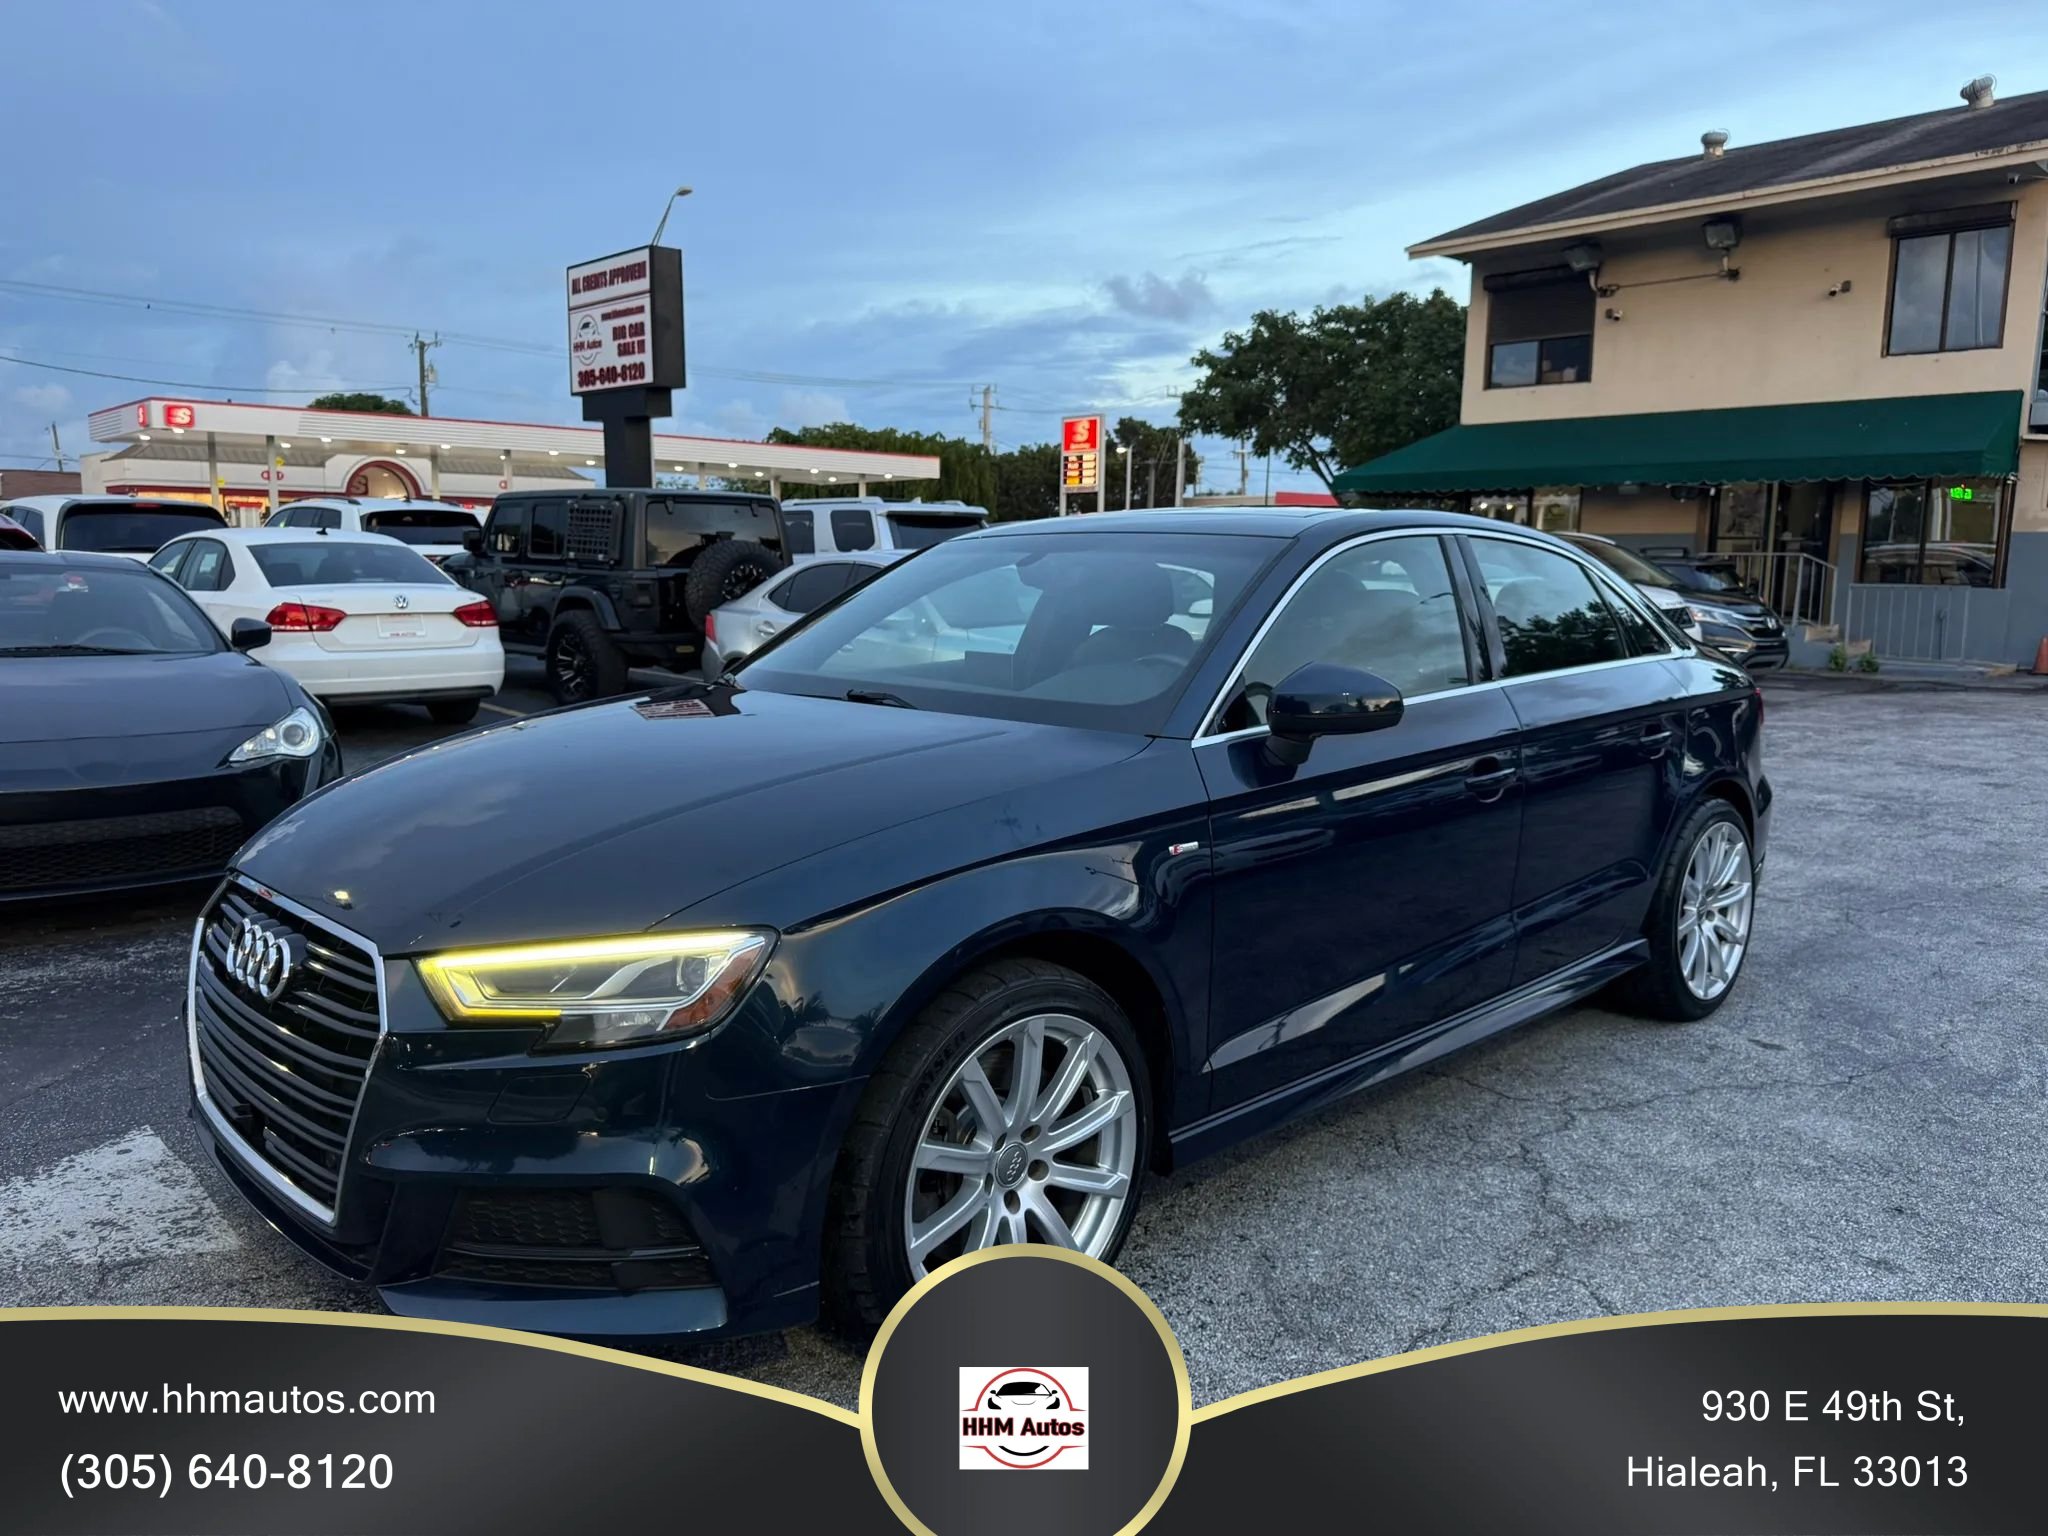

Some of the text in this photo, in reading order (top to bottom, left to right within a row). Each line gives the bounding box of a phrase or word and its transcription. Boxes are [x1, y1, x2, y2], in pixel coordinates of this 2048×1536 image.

[572, 278, 581, 295] ALL
[582, 271, 607, 292] CREDITS
[612, 321, 645, 342] BIG CAR
[617, 341, 635, 357] SALE
[577, 362, 645, 388] 305-640-8120
